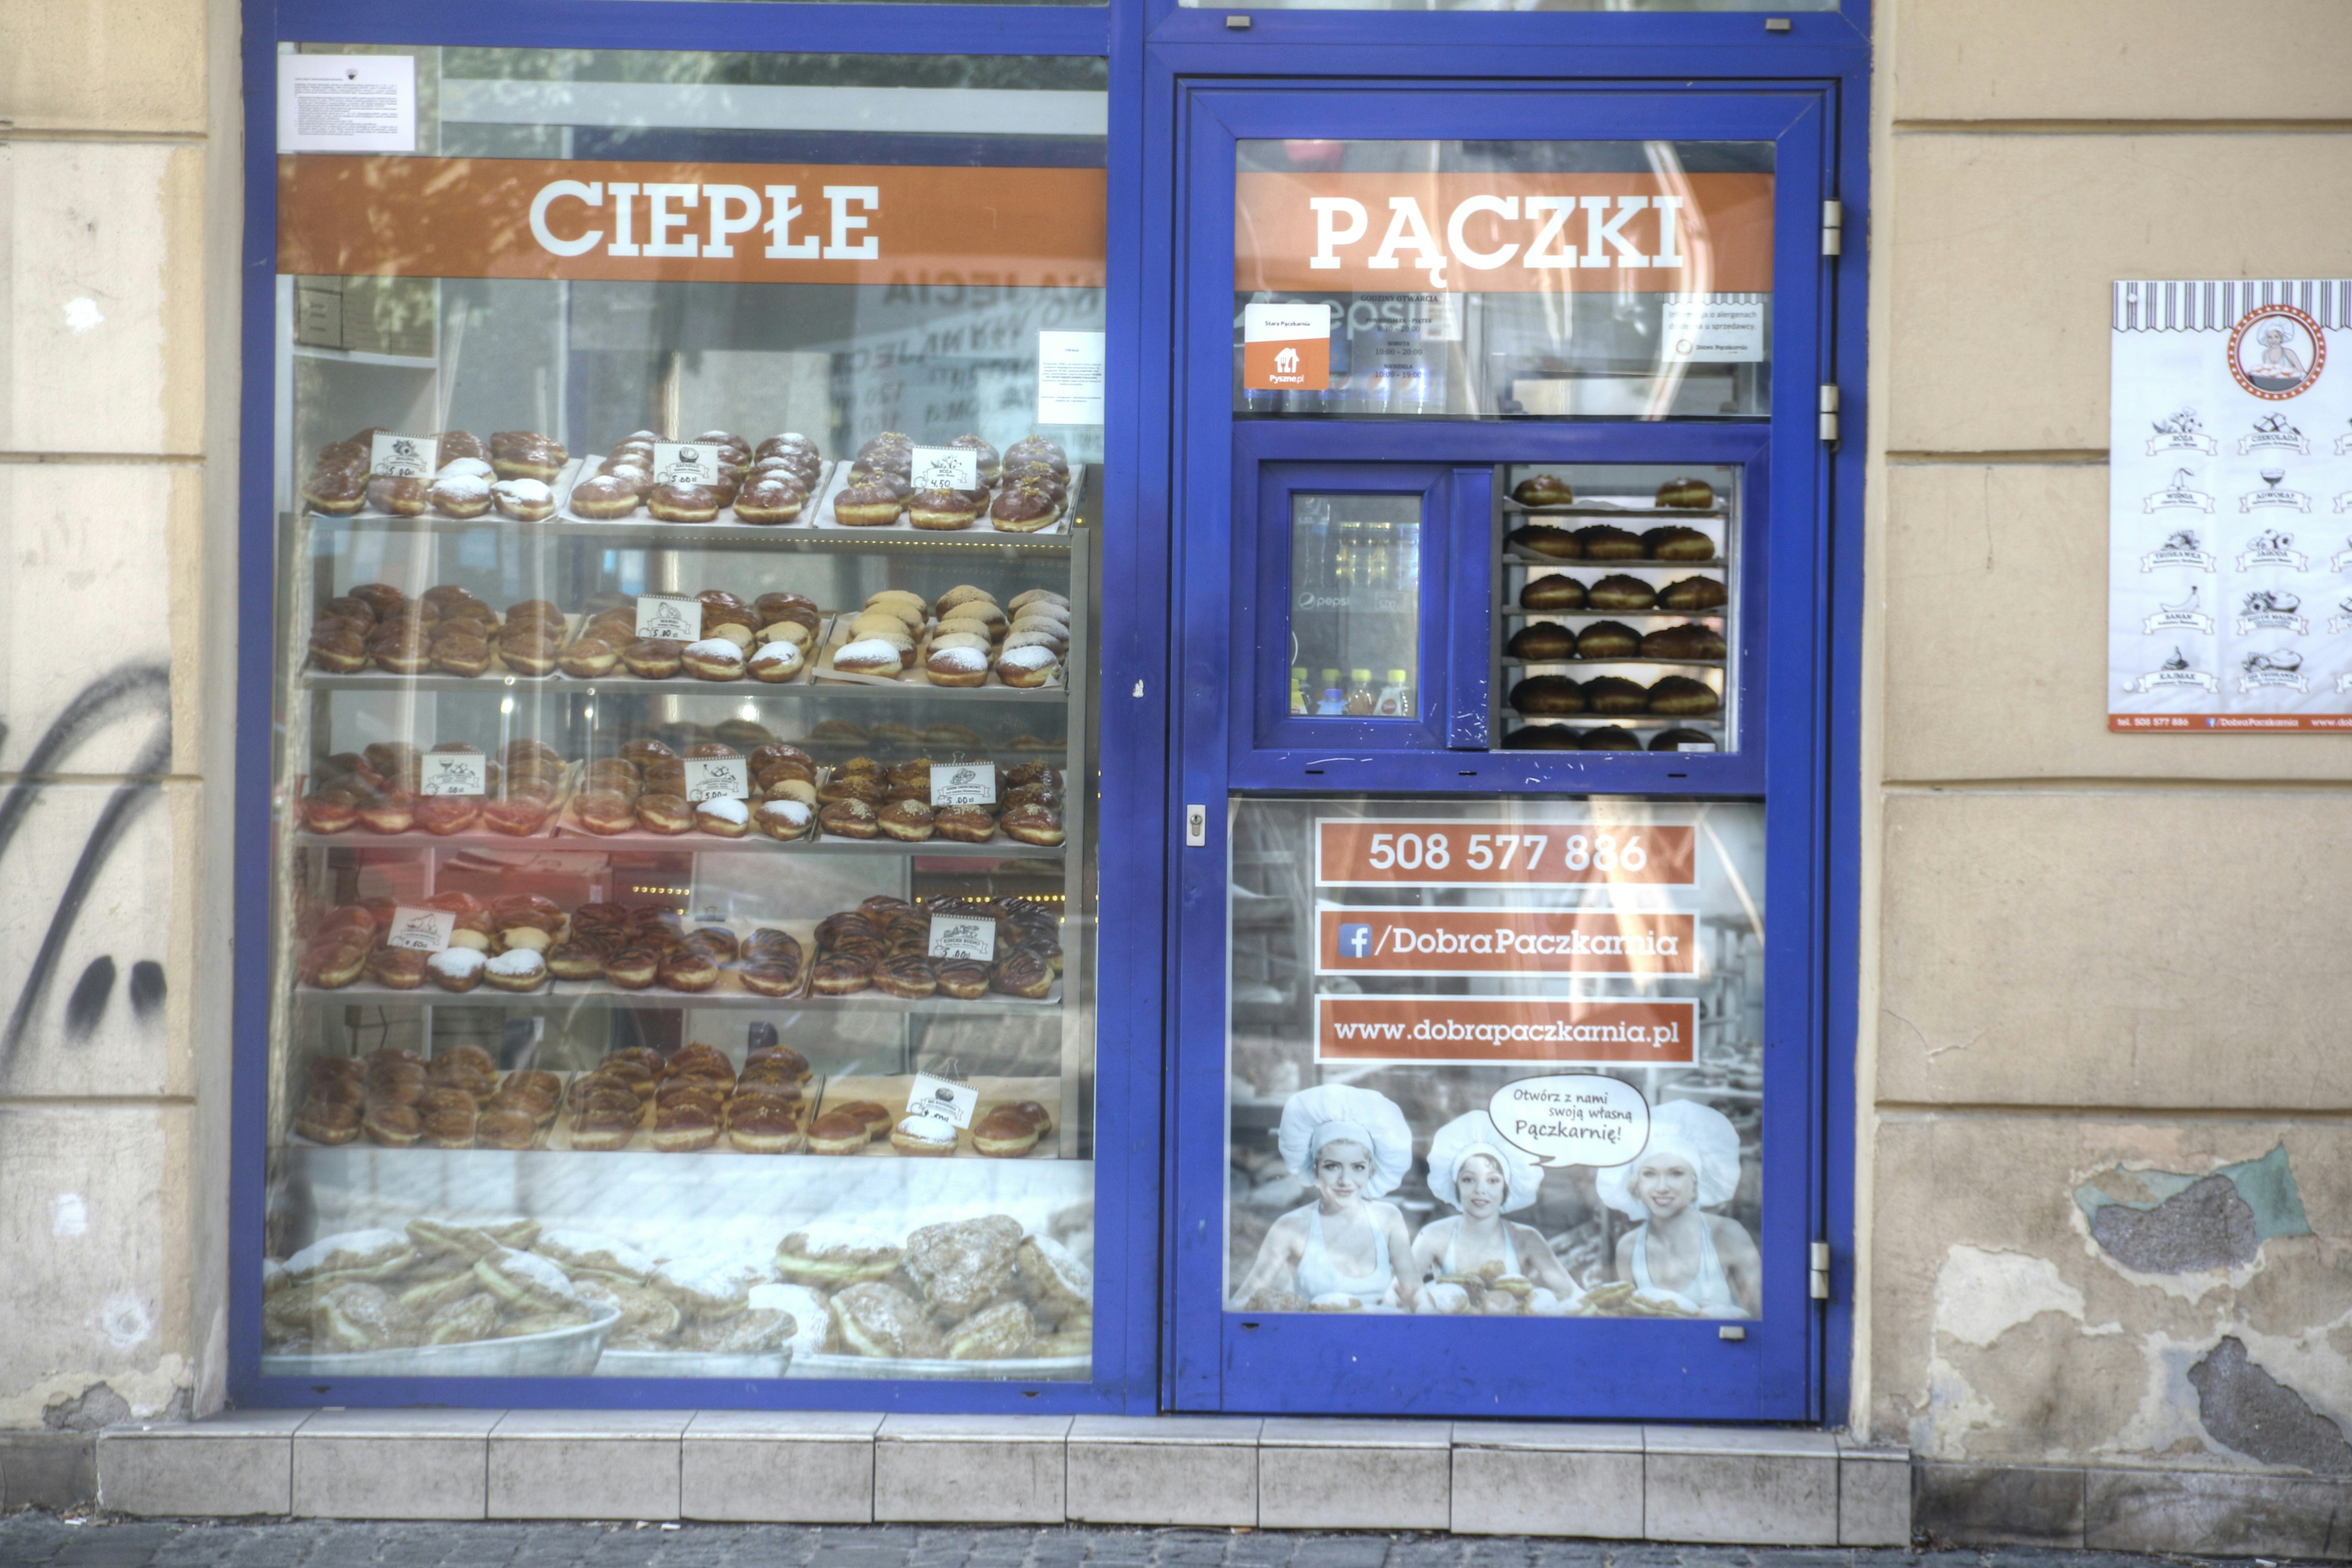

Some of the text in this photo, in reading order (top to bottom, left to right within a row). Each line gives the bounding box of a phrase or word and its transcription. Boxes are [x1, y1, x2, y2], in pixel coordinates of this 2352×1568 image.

[530, 180, 879, 260] CIEPŁE
[1310, 195, 1683, 288] PĄCZKI
[1269, 374, 1304, 384] Pyszne.pl
[1317, 596, 1349, 607] pepsi
[2117, 718, 2132, 726] tel.
[2134, 718, 2152, 726] 508
[2153, 718, 2171, 726] 577
[2171, 718, 2189, 726] 886
[1369, 833, 1647, 872] 508 577 886
[1334, 1019, 1679, 1048] www.dobrapaczkarnia.pl
[1513, 1088, 1608, 1104] Otwórz z nami
[1549, 1105, 1632, 1123] swoją własną
[1515, 1119, 1621, 1144] Pączkarnię!
